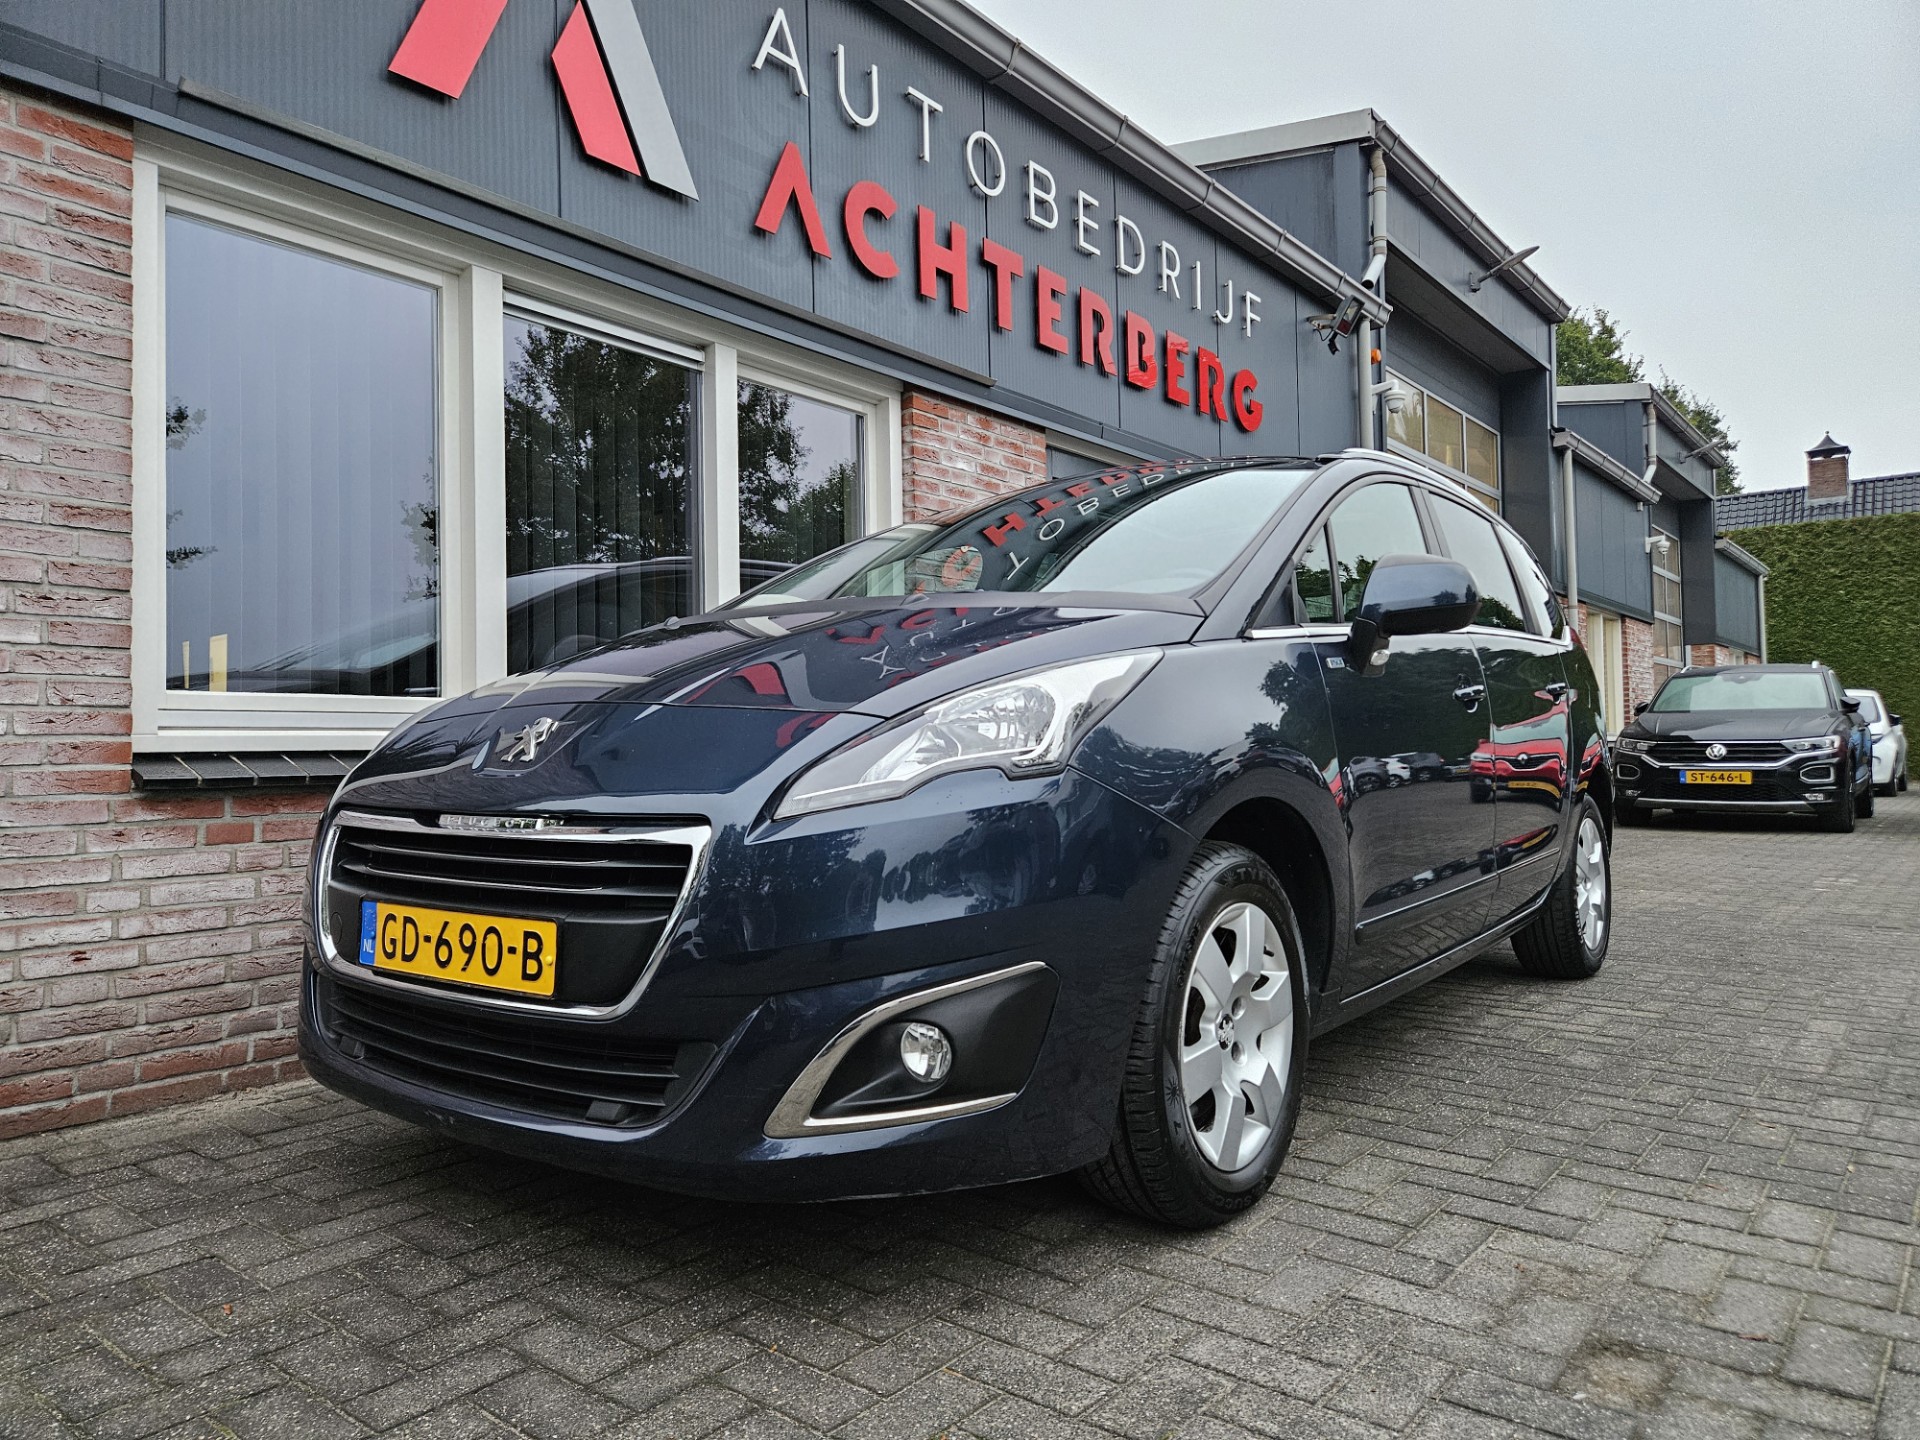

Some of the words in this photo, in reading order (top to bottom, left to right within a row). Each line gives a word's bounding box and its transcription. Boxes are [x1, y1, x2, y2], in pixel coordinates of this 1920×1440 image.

[752, 7, 1262, 337] AUTOBEDRIJF
[754, 141, 1263, 432] ACHTERBERG
[1691, 773, 1746, 782] ST-646-L
[363, 938, 374, 954] NL
[381, 912, 544, 982] GD-690-B
